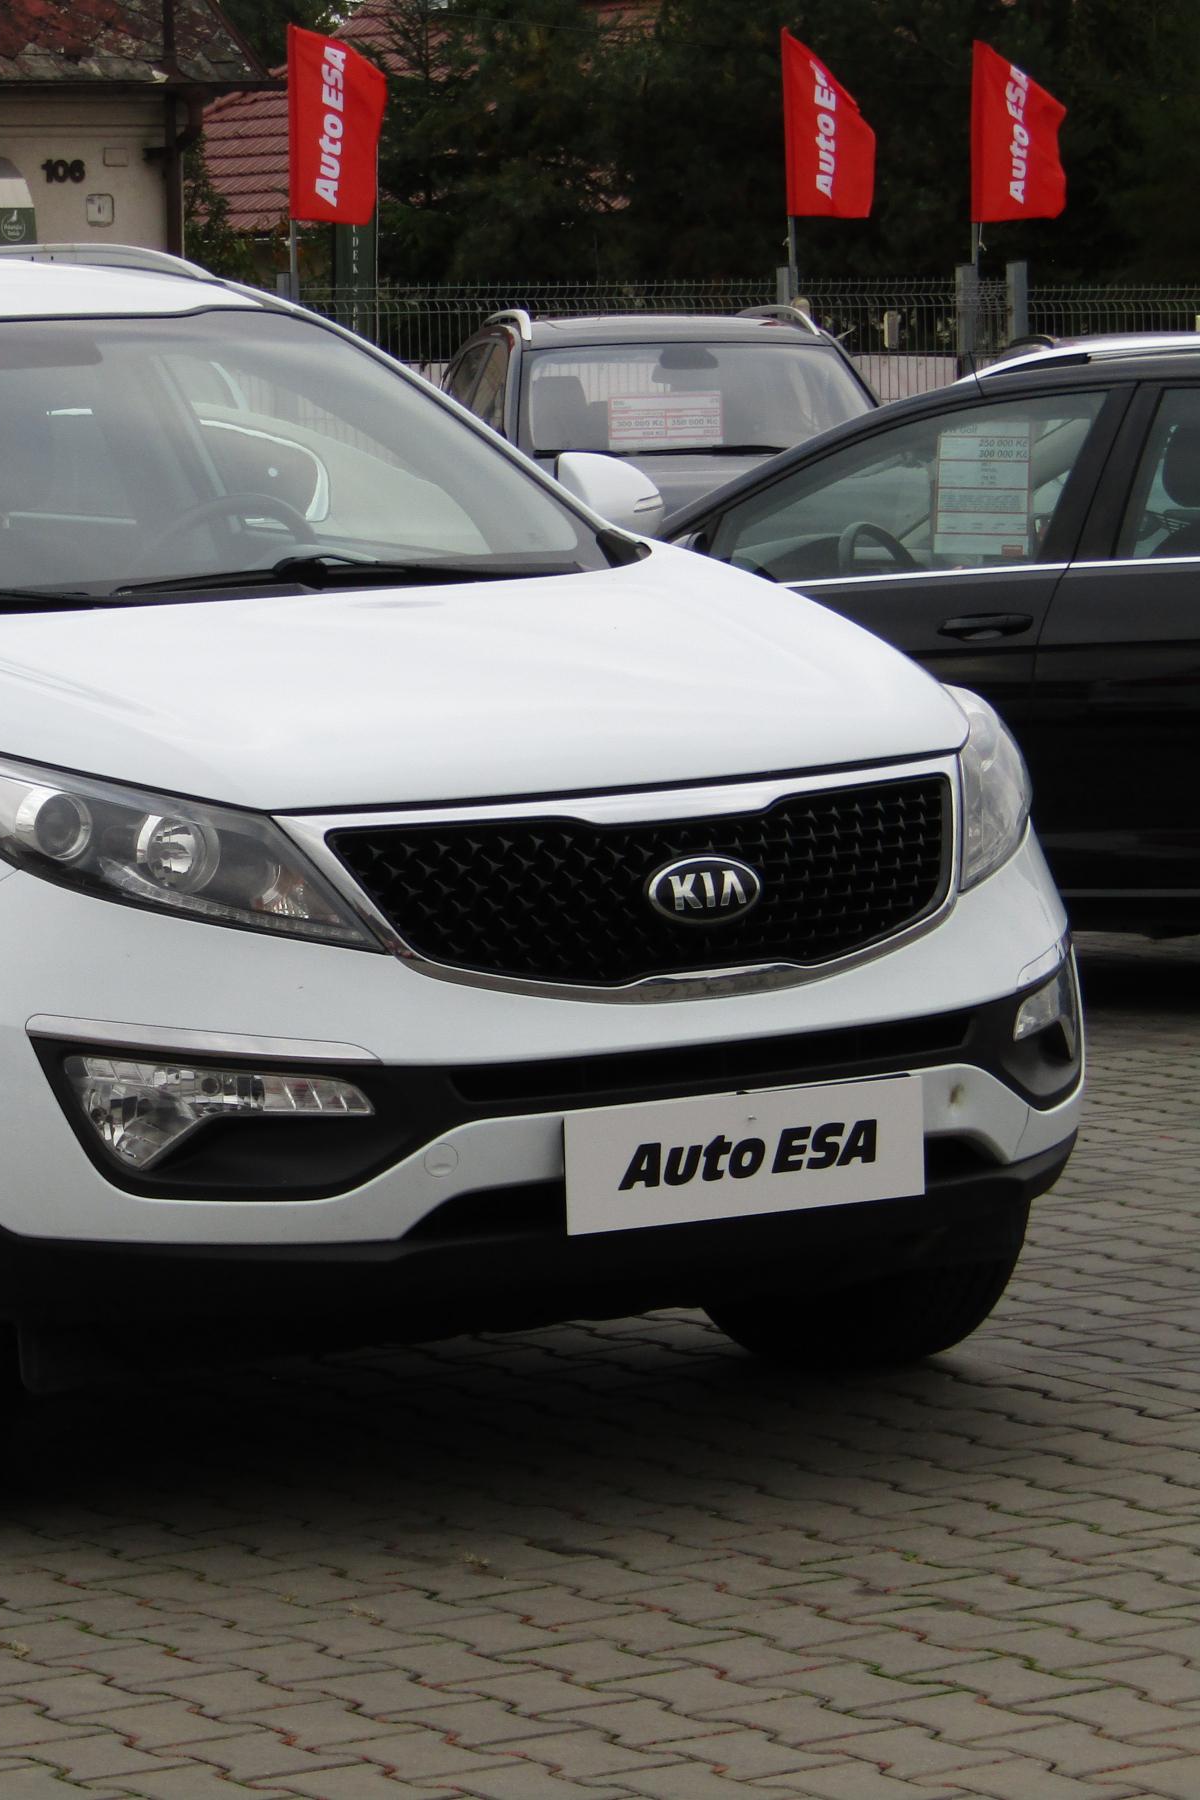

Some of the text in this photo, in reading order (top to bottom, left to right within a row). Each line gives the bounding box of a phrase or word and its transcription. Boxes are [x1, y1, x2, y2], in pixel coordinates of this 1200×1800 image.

[315, 46, 347, 208] Auto ESA
[815, 112, 837, 200] Auto
[1009, 123, 1030, 204] Auto
[41, 159, 86, 184] 106
[668, 869, 748, 911] KIA
[618, 1119, 878, 1191] Auto ESA
